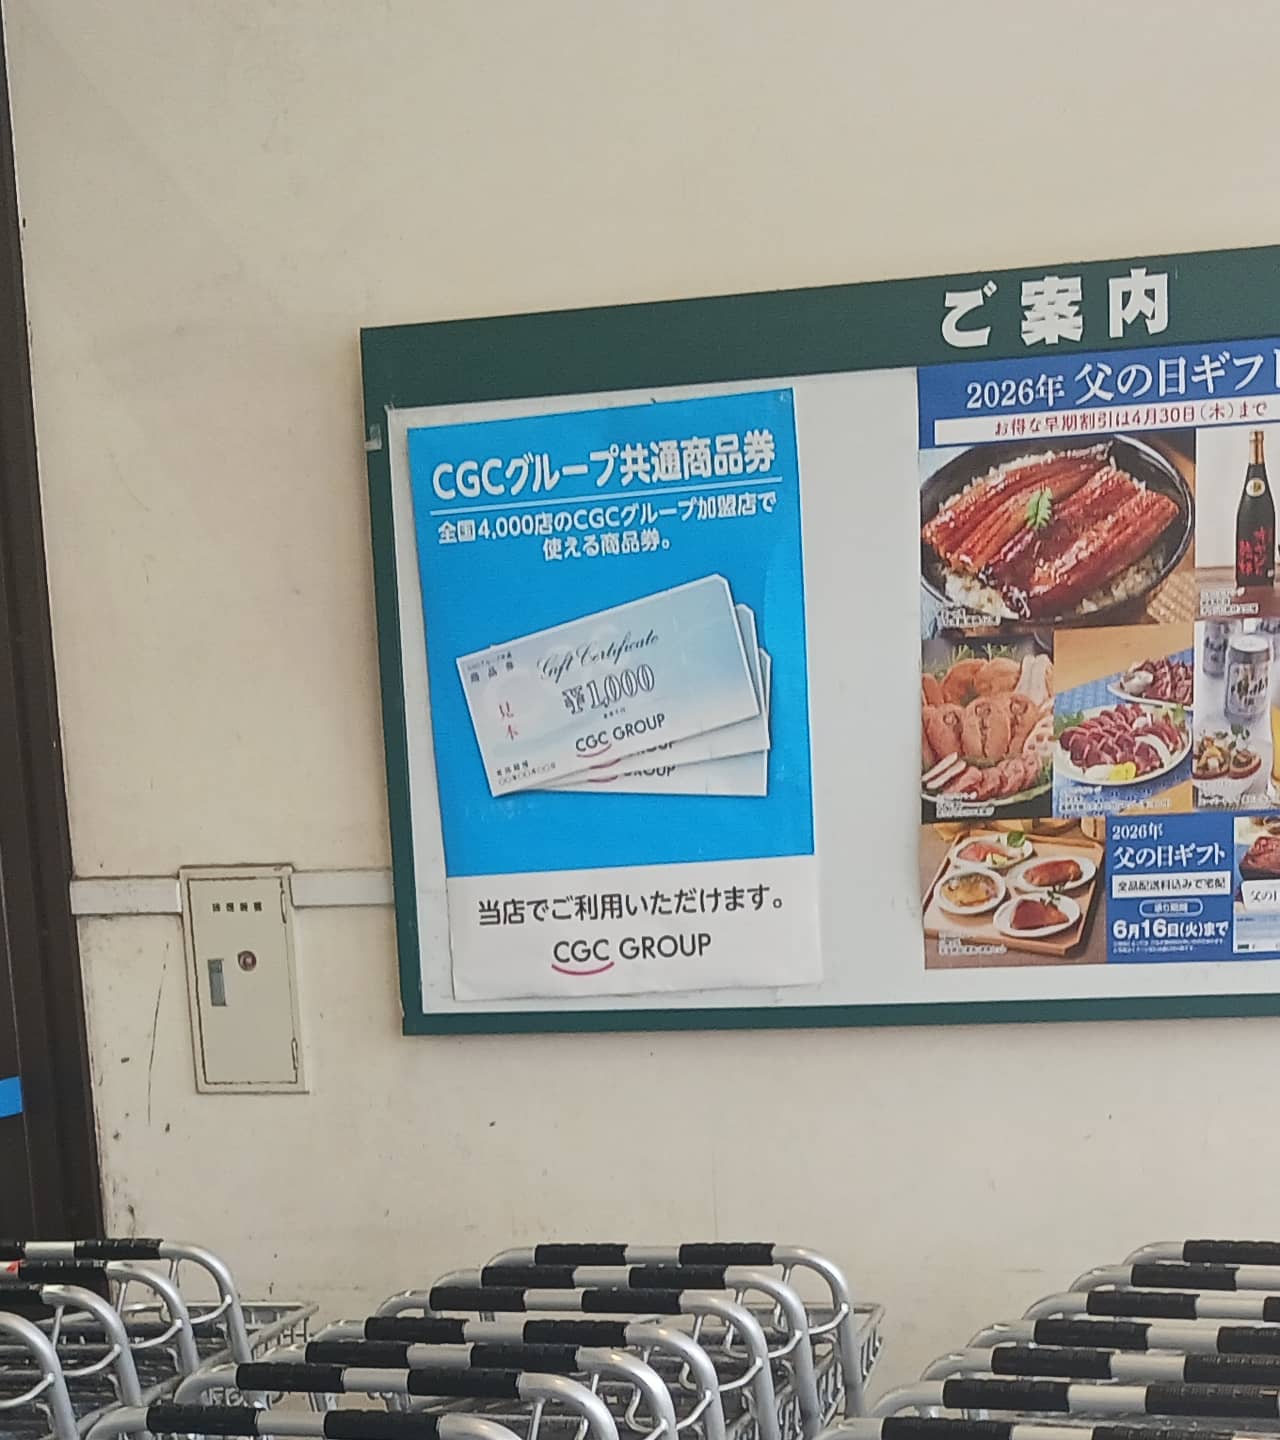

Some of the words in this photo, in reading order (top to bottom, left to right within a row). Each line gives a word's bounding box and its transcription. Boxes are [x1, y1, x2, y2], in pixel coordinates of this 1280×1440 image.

[940, 267, 1170, 348] ご案内
[966, 373, 1066, 409] 2026年
[432, 429, 776, 500] CGCグループ共通商品券
[438, 491, 777, 545] 全国4,000店のCGCグループ加盟店で
[543, 529, 671, 561] 使える商品券。
[562, 664, 656, 714] ¥1,000
[575, 731, 609, 752] CGC
[612, 713, 666, 741] GROUP
[1112, 822, 1164, 840] 2026年
[1113, 843, 1226, 869] 父の日ギフト
[477, 884, 783, 926] 当店でご利用いただけます。
[553, 940, 611, 963] CGC
[619, 933, 712, 960] GROUP
